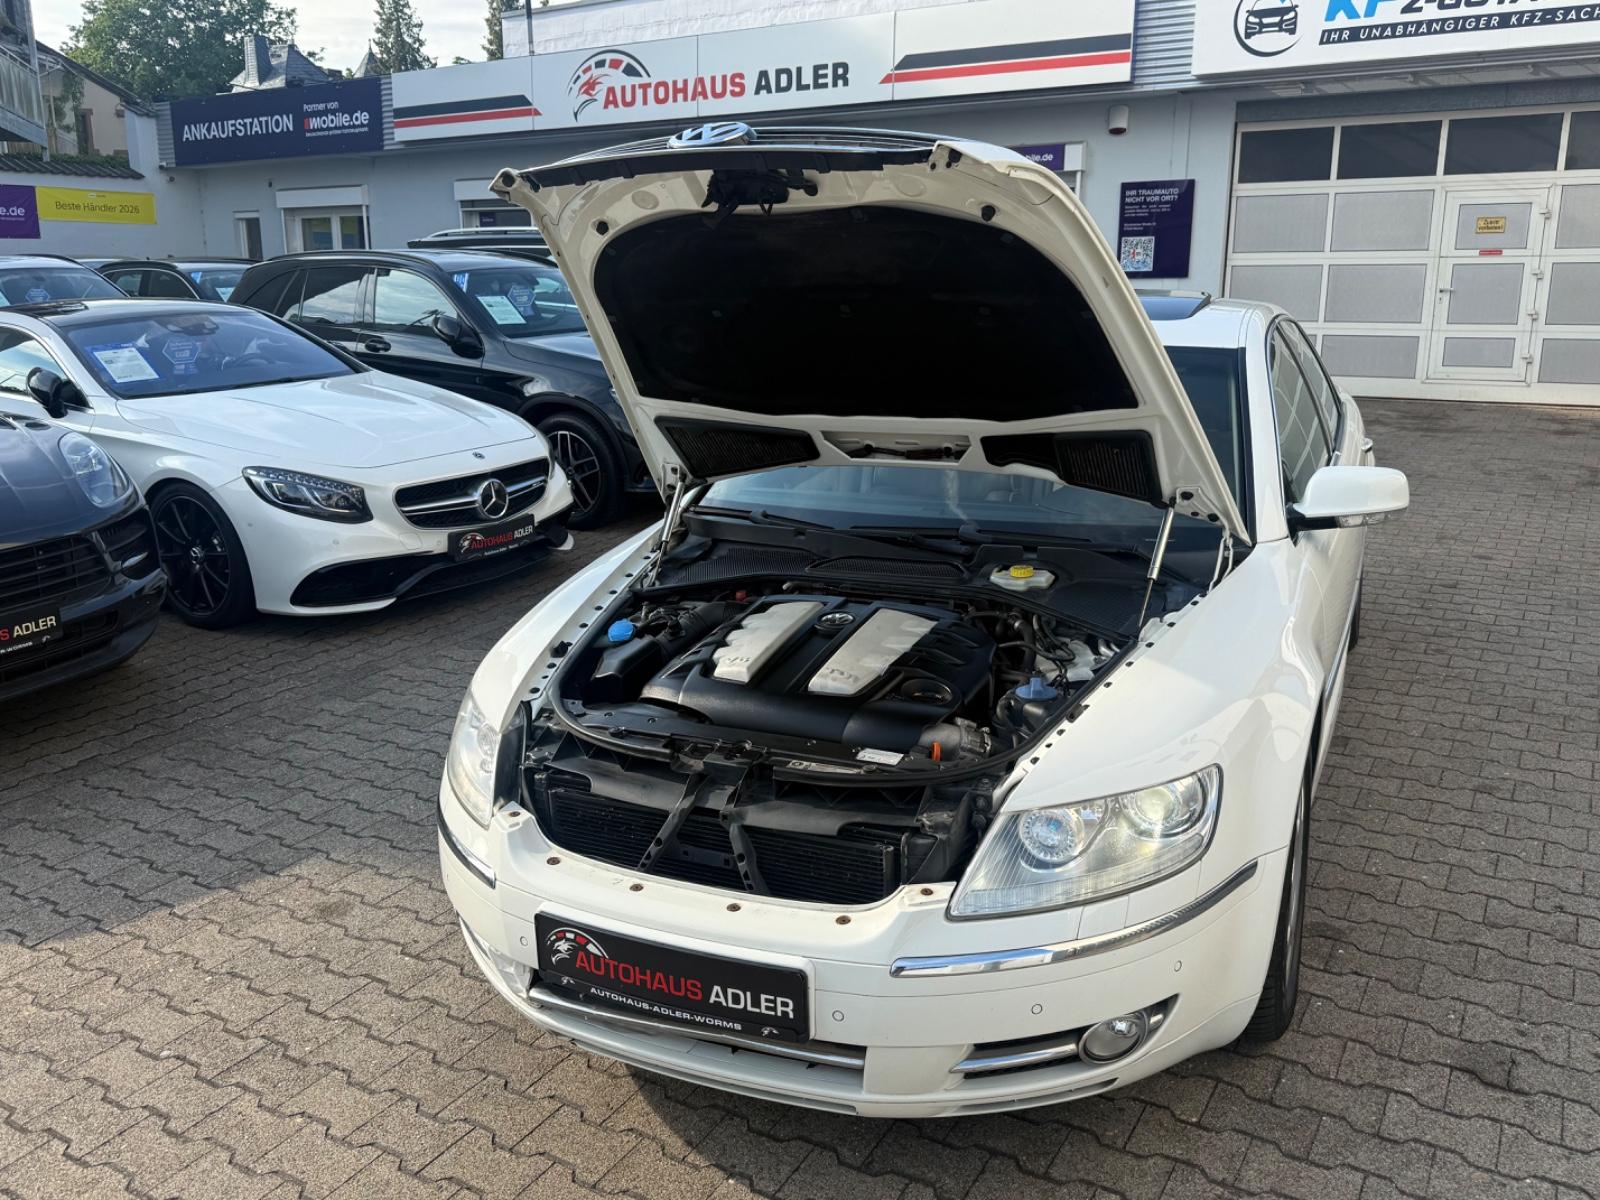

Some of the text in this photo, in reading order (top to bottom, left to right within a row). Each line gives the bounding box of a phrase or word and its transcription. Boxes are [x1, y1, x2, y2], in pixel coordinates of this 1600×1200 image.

[1323, 30, 1350, 42] IHR
[1360, 16, 1499, 39] UNABHÄNGIGER
[603, 61, 850, 109] AUTOHAUS ADLER
[183, 114, 294, 142] ANKAUFSTATION
[304, 110, 369, 130] mobile.de
[1138, 188, 1179, 196] TRAUMAUTO
[55, 201, 140, 214] Beste Händler 2026
[471, 525, 533, 549] AUTOHAUS ADLER
[13, 615, 56, 638] ADLER
[575, 950, 795, 1019] AUTOHAUS ADLER
[590, 987, 743, 1031] AUTOHAUS-ADLER-WORMS
